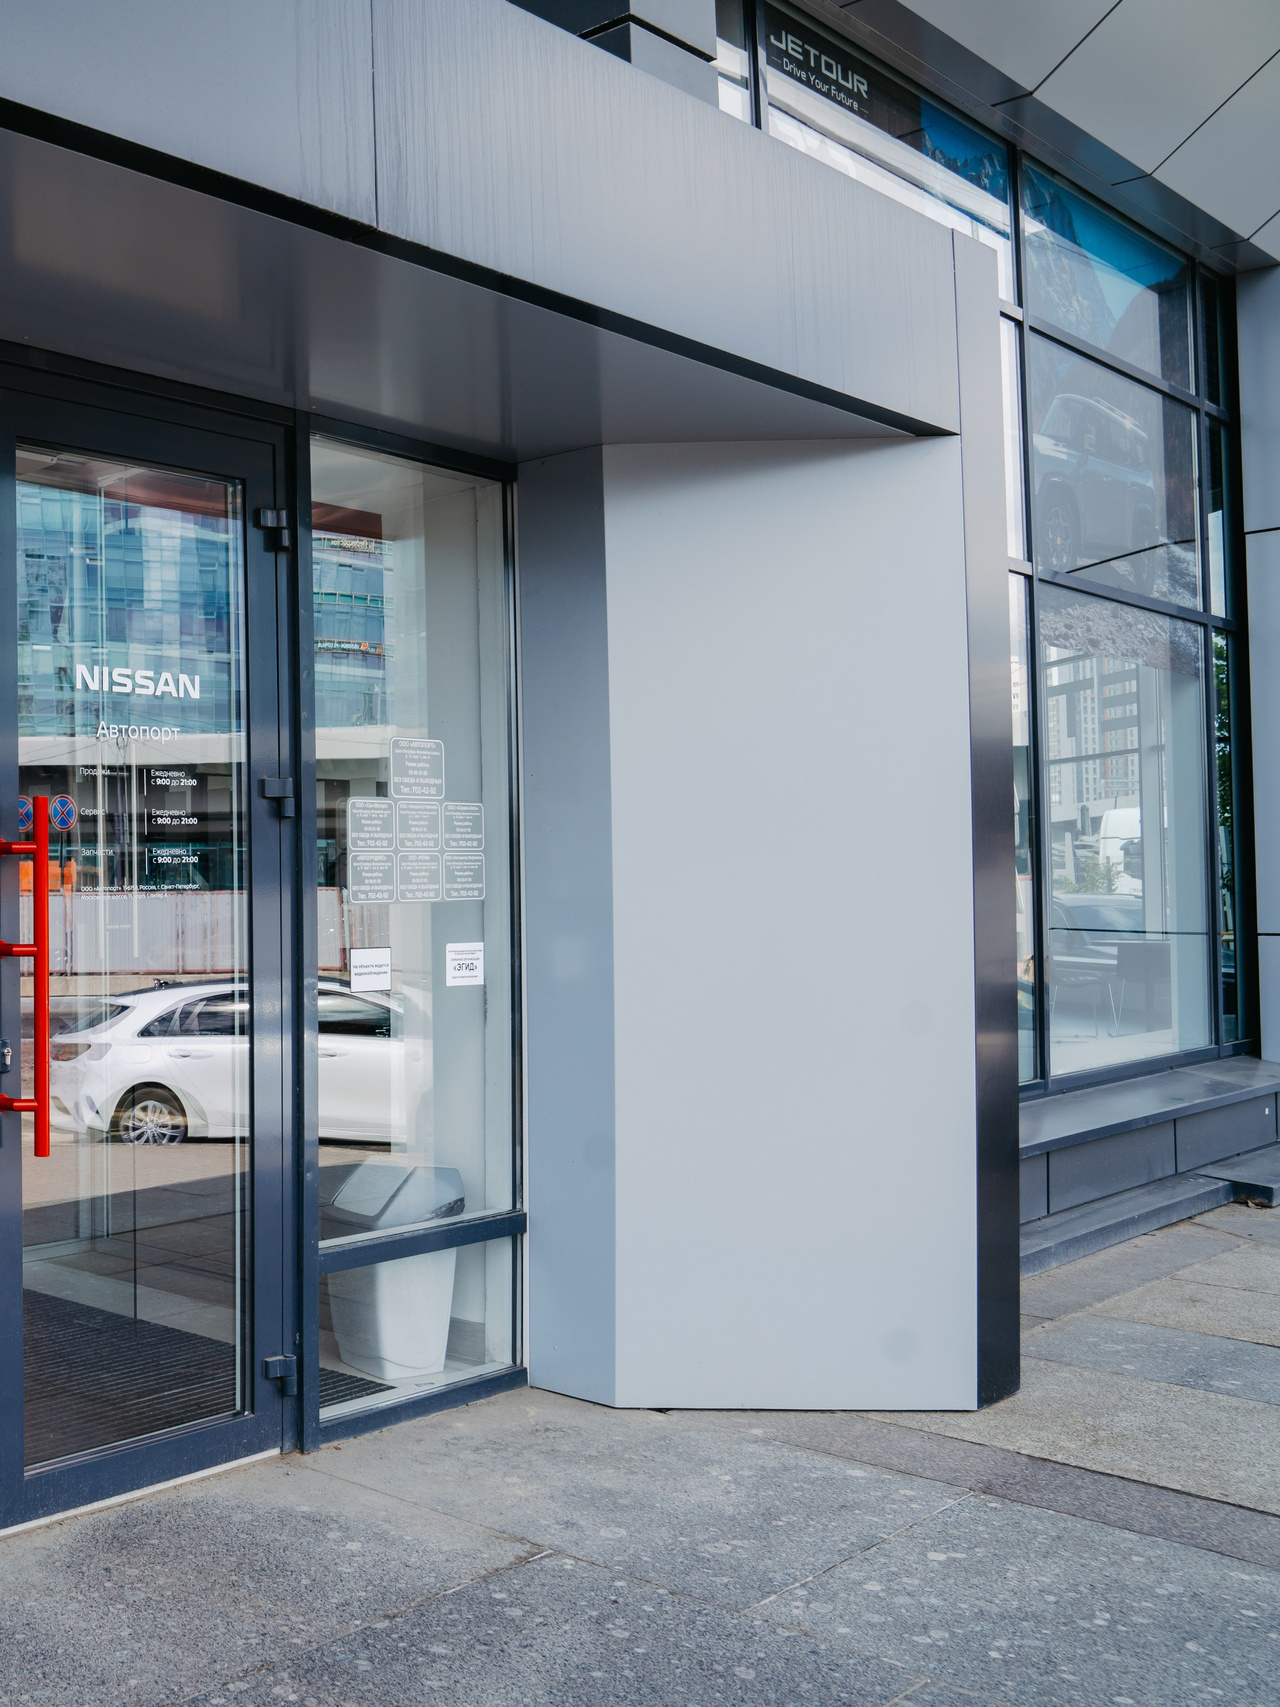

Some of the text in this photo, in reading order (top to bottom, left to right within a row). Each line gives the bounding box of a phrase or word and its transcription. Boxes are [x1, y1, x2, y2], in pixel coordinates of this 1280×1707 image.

[770, 30, 868, 99] JETOUR
[783, 57, 858, 111] Drive Your Future
[75, 664, 200, 699] NISSAN
[96, 720, 180, 745] Автопорт
[79, 767, 110, 777] Продажи
[151, 769, 185, 778] Ежедневно
[180, 778, 197, 786] 21:00
[80, 808, 106, 817] Сервис
[151, 808, 186, 817] Ежедневно
[157, 817, 171, 825] 9:00
[181, 817, 198, 825] 21:00
[81, 848, 113, 856] Запчасти
[152, 848, 186, 856] Ежедневно
[453, 962, 478, 972] «ЭГИД»
